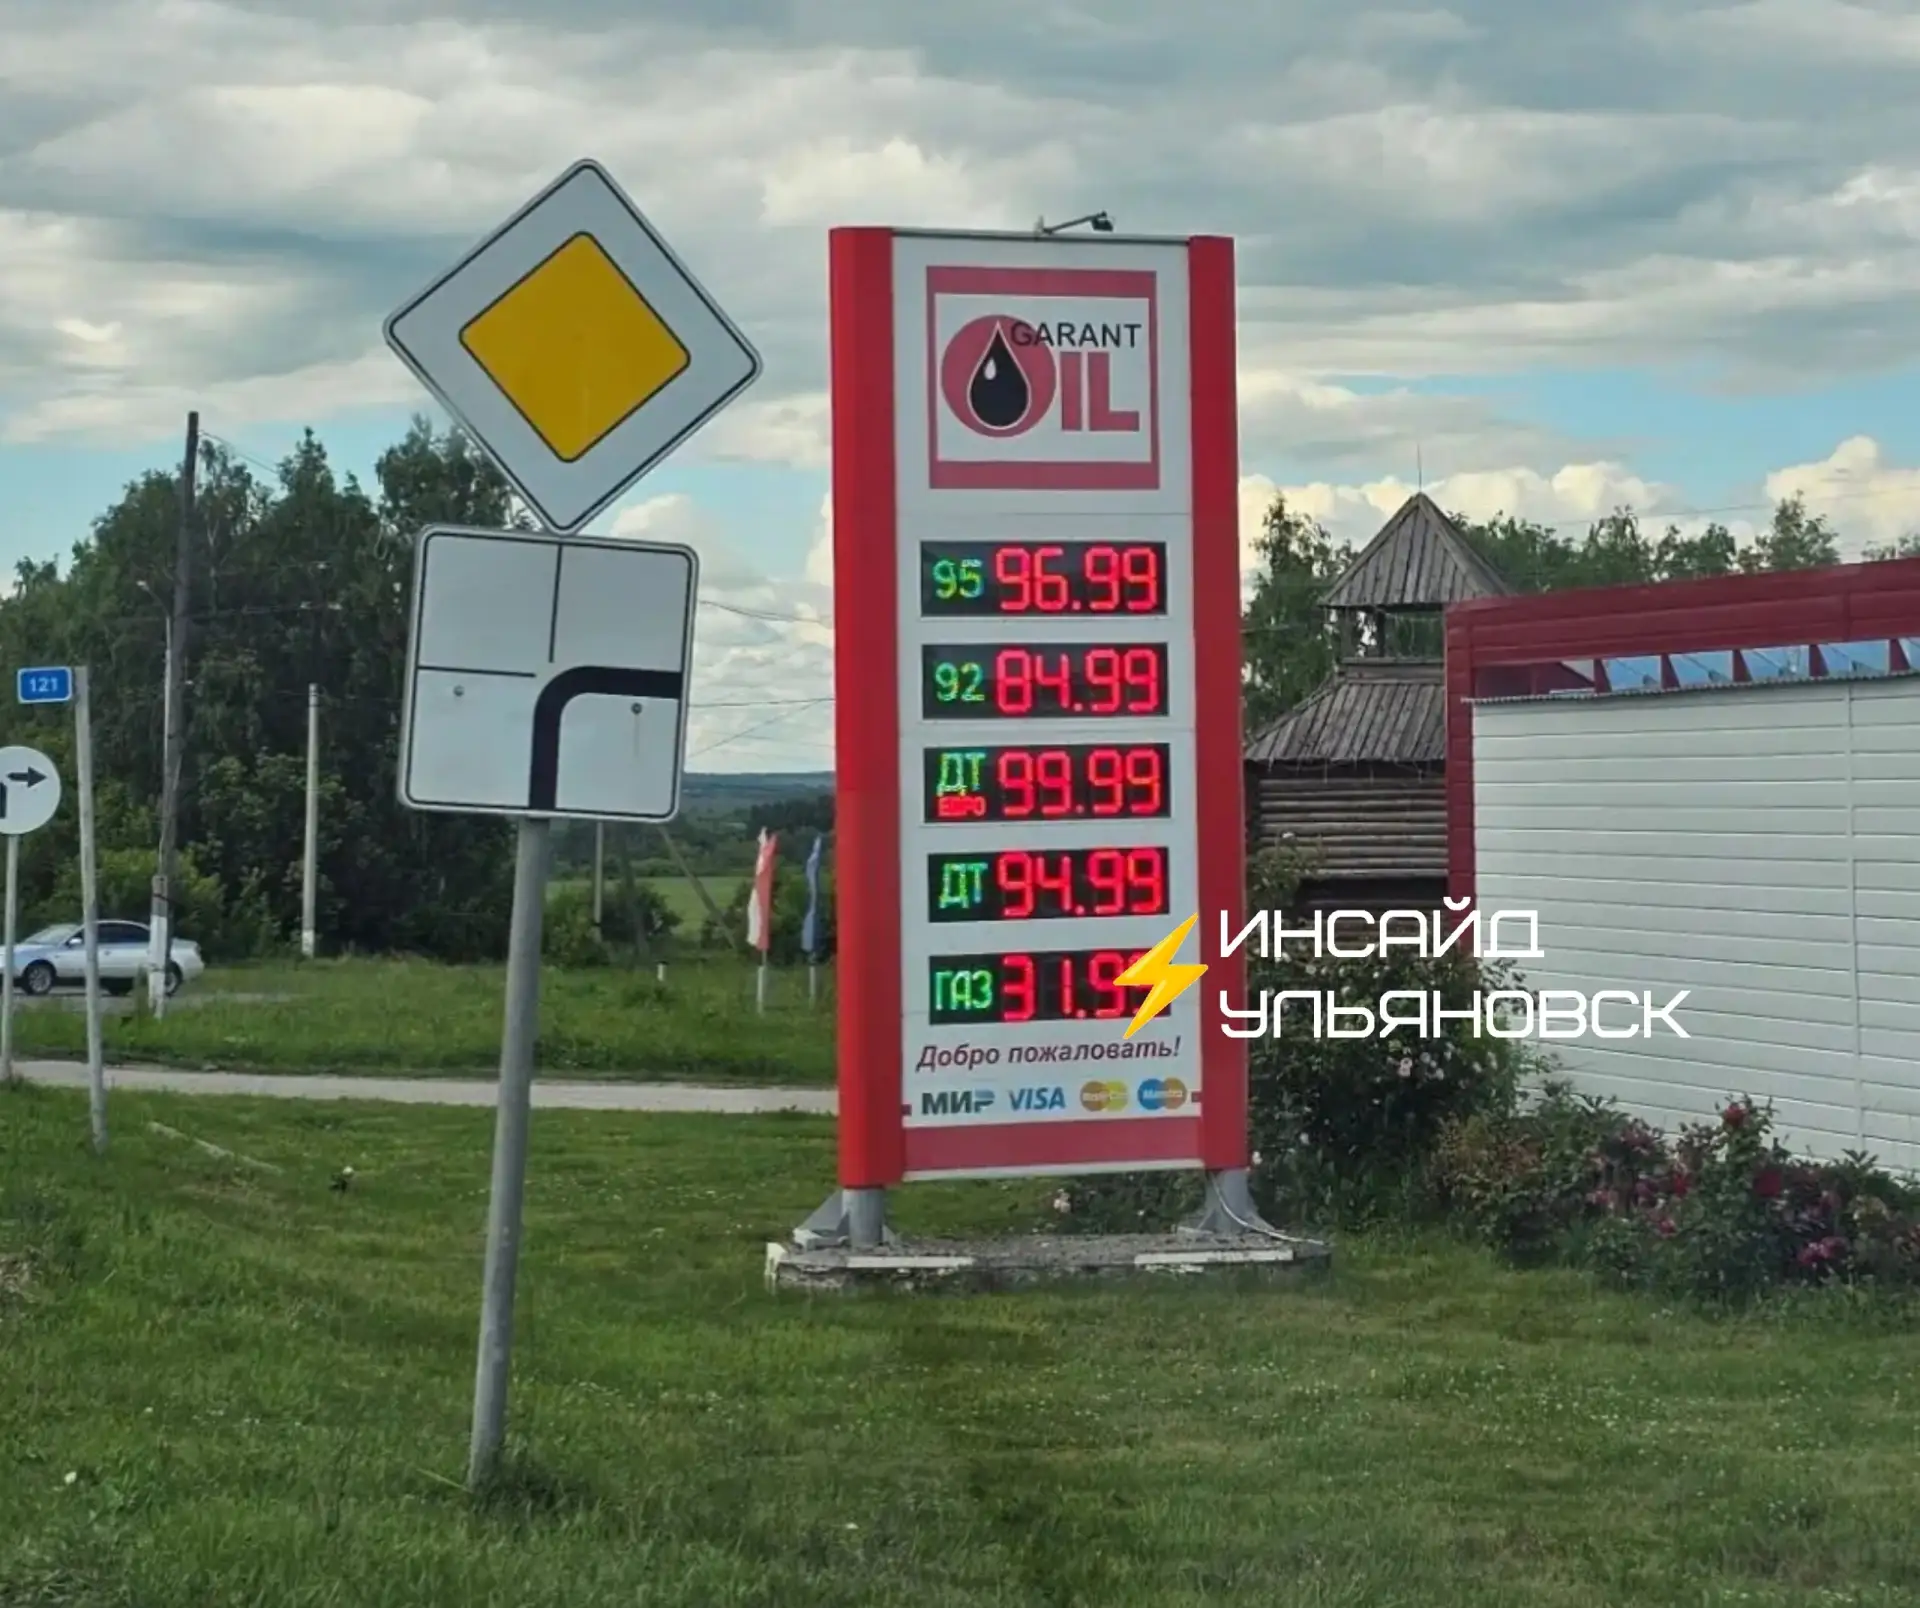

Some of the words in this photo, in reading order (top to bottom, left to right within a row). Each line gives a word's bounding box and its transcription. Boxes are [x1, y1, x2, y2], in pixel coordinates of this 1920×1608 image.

[1010, 321, 1142, 349] GARANT
[942, 314, 1140, 438] OIL
[933, 559, 984, 598] 95
[996, 547, 1157, 611] 96.99
[30, 677, 58, 692] 121
[935, 662, 985, 701] 92
[997, 649, 1158, 713] 84.99
[938, 752, 986, 797] ДТ
[1000, 750, 1161, 815] 99.99
[939, 862, 988, 909] ДТ
[999, 850, 1161, 915] 94.99
[934, 969, 994, 1011] ГАЗ
[915, 1044, 999, 1073] Добро
[1007, 1036, 1181, 1064] пожаловать!
[921, 1089, 995, 1115] МИР
[1009, 1086, 1067, 1111] VISA
